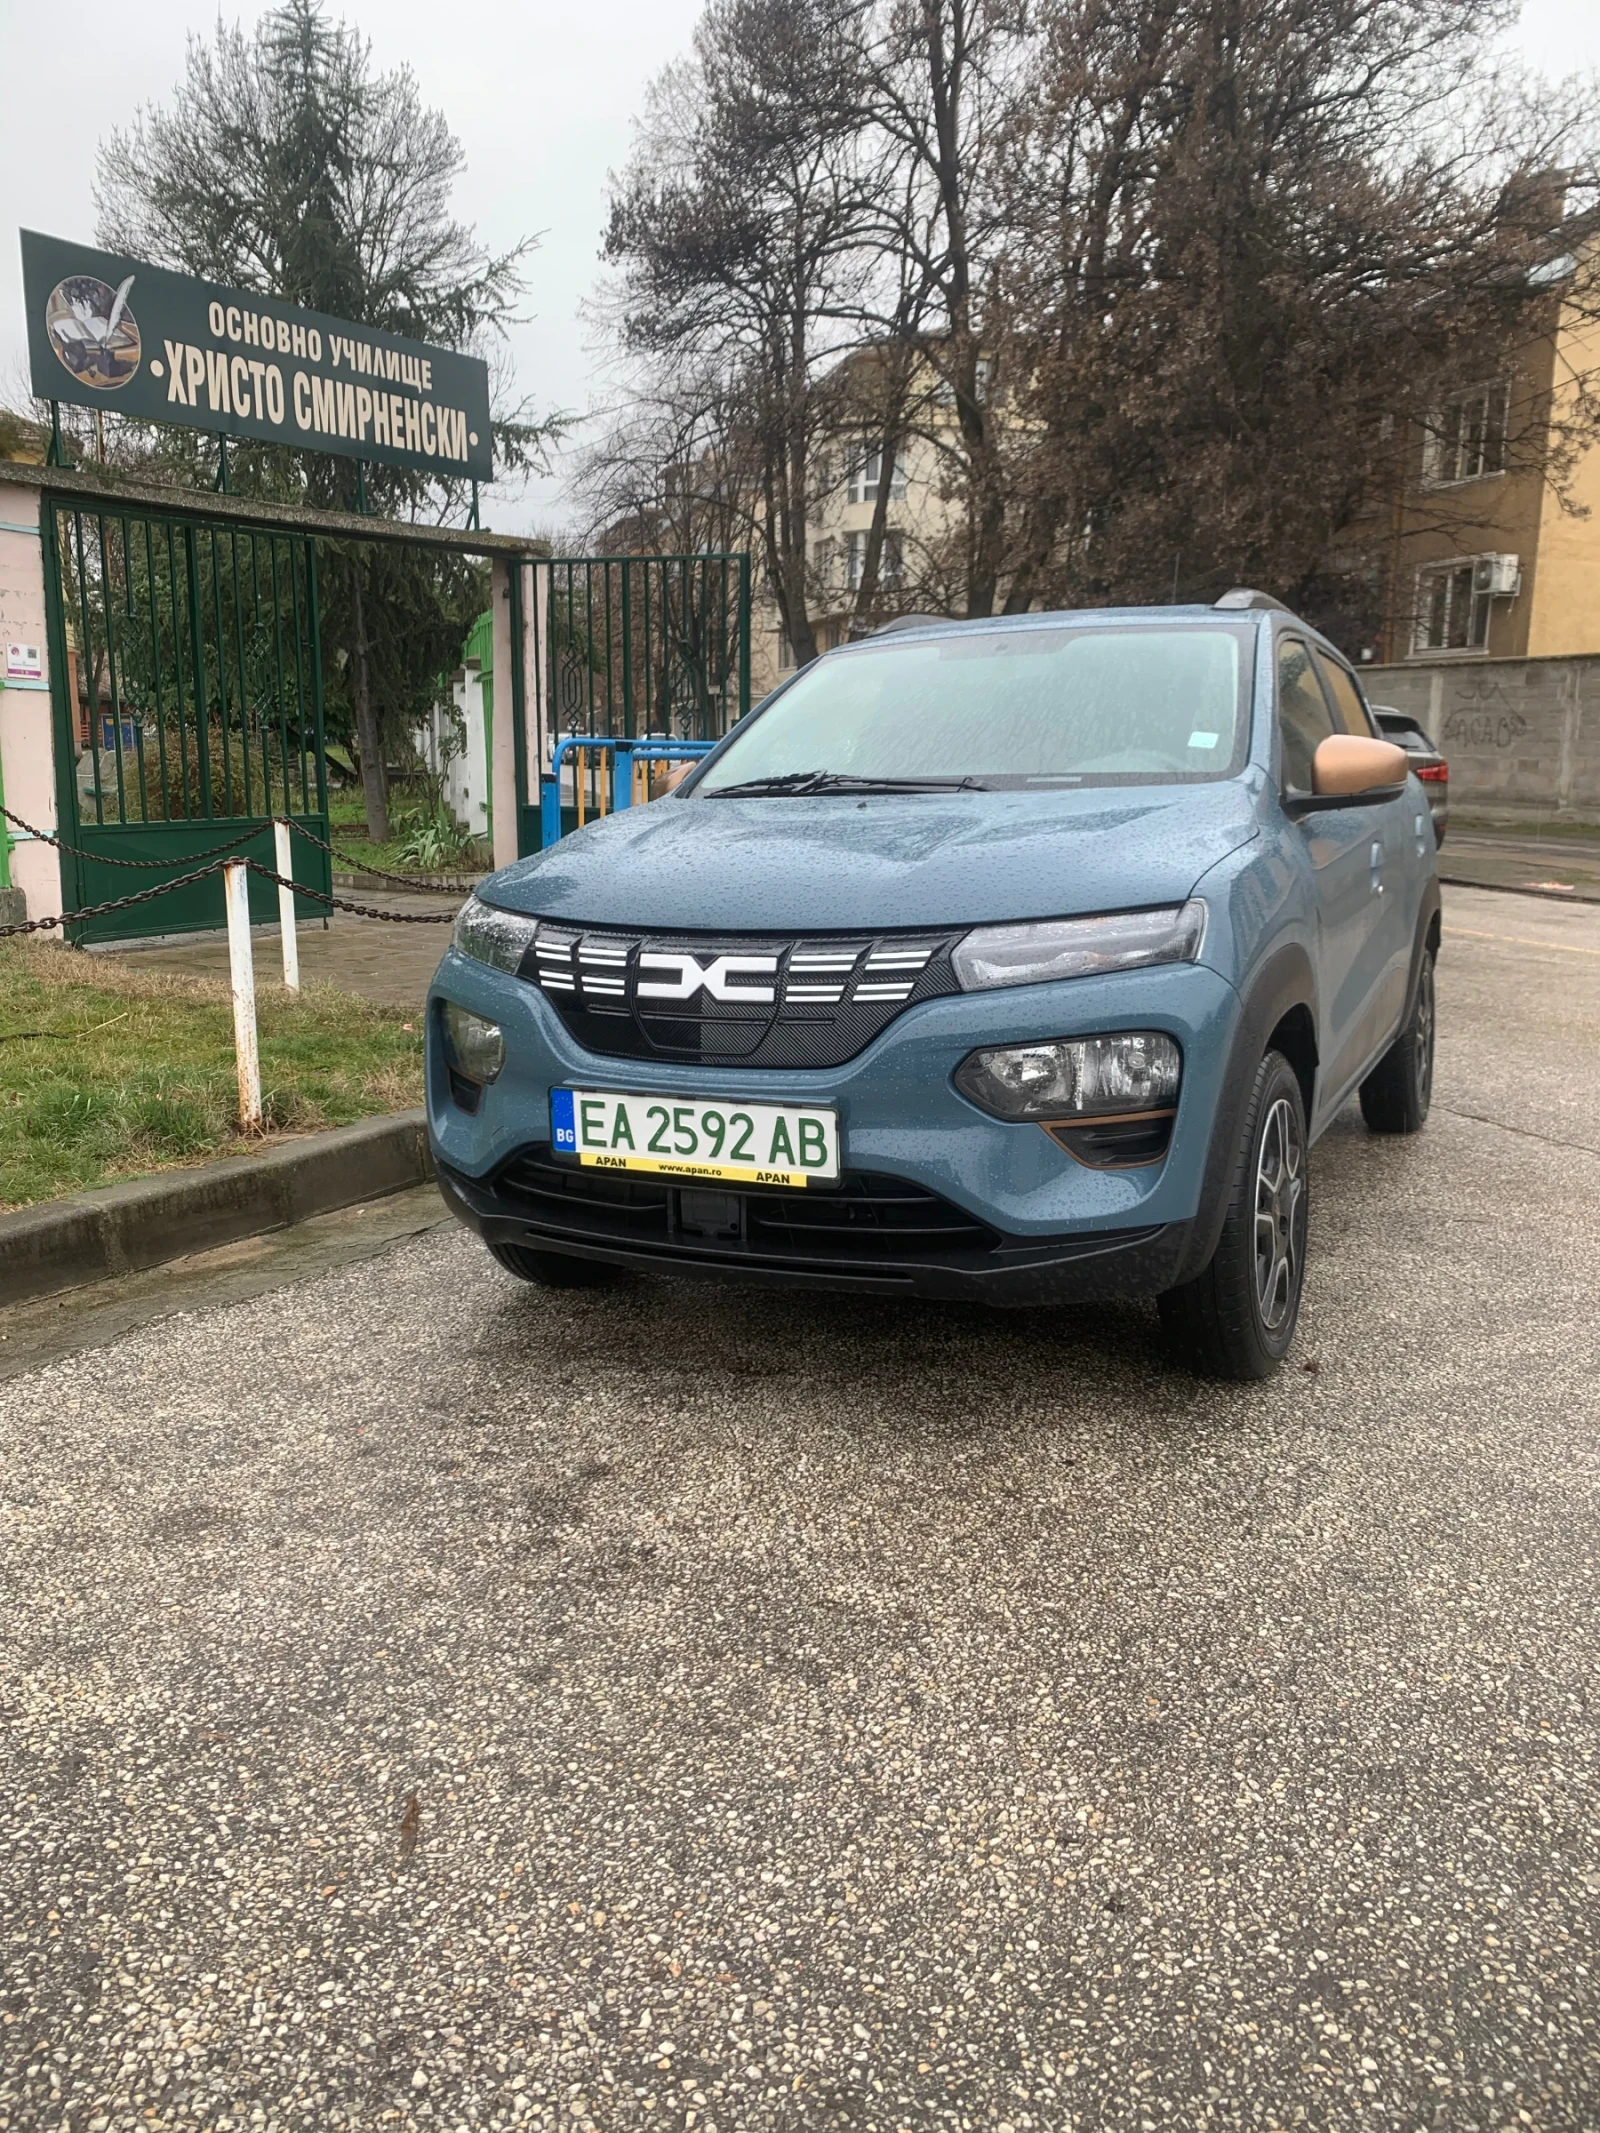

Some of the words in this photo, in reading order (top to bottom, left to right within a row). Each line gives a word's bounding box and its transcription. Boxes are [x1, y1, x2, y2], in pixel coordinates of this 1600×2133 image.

[208, 301, 322, 362] ОСНОВНО
[329, 335, 433, 393] УЧИЛИЩЕ
[556, 1128, 574, 1143] BG
[580, 1099, 636, 1151] EA
[646, 1105, 756, 1162] 2592
[768, 1115, 828, 1168] AB
[595, 1156, 627, 1168] APAN
[658, 1163, 722, 1177] www.apan.ro
[756, 1171, 790, 1185] APAN
